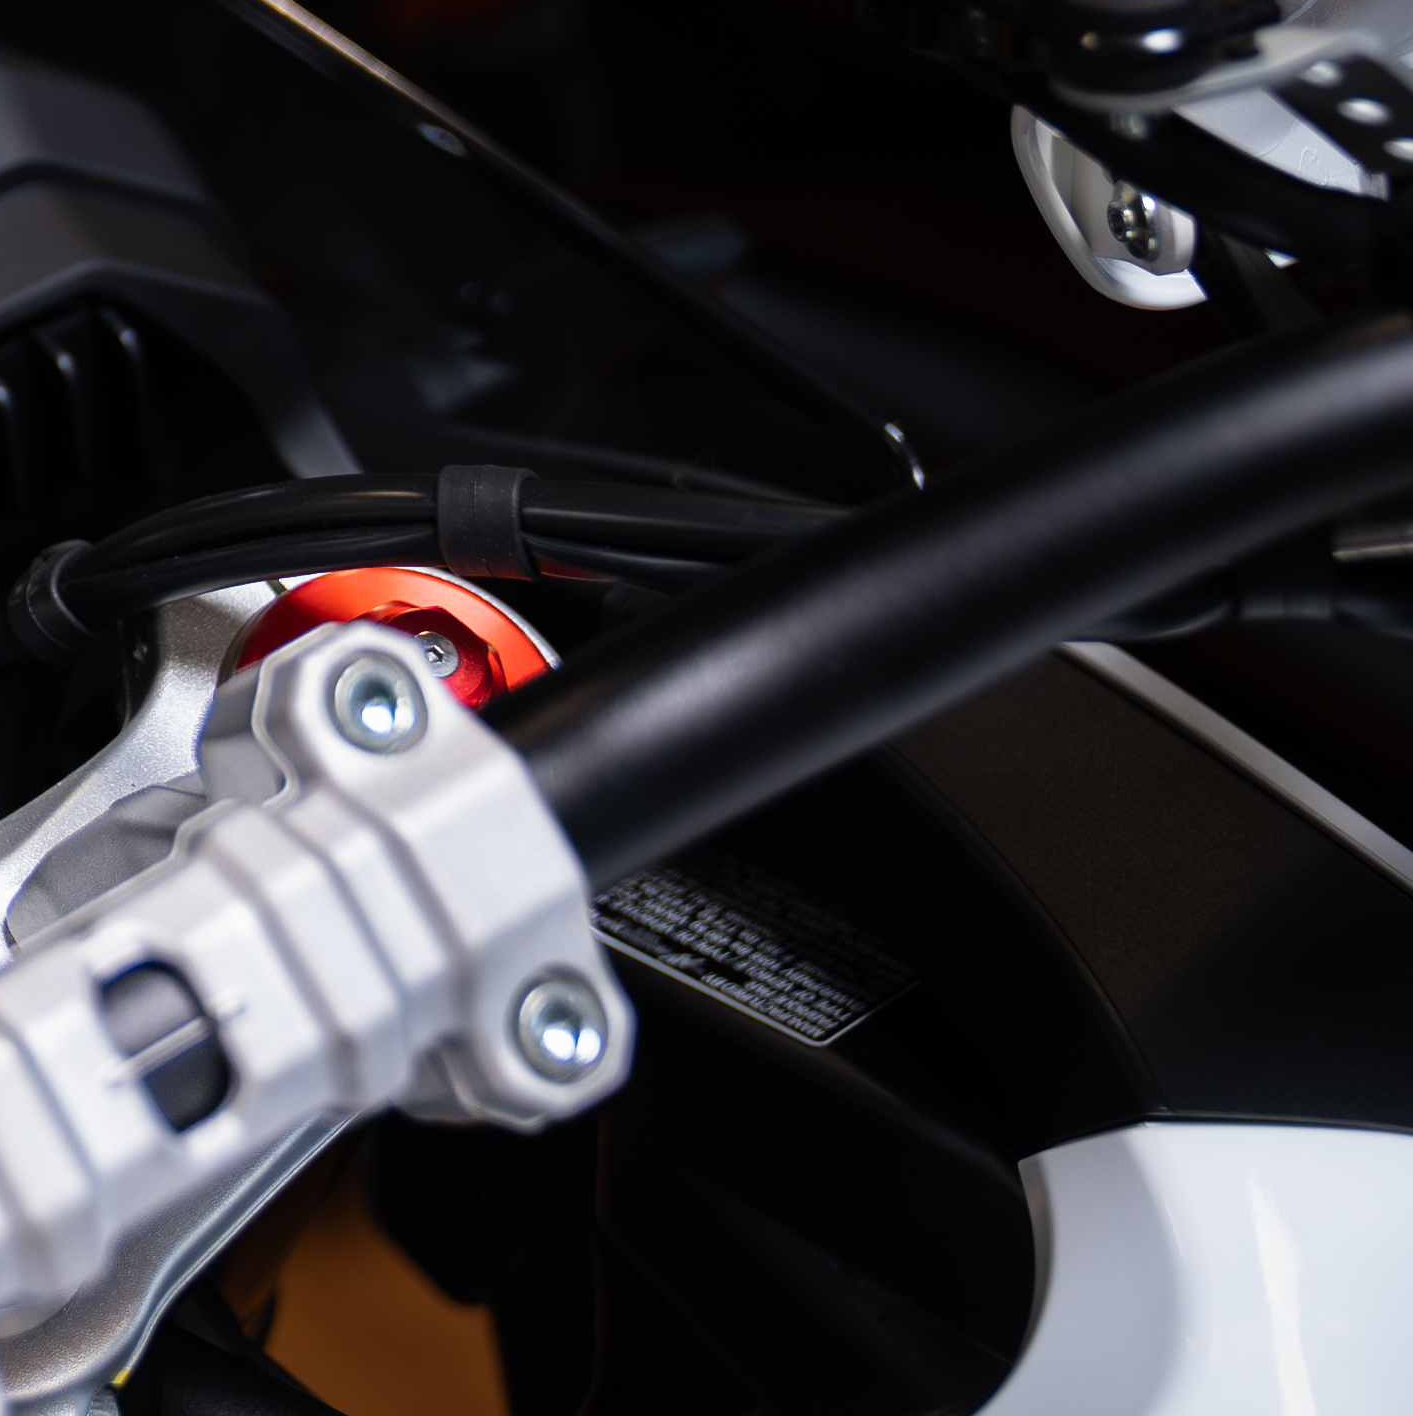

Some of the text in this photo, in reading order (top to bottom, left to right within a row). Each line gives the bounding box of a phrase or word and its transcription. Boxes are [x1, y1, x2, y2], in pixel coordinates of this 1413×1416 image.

[688, 937, 732, 962] TYPE
[731, 957, 796, 994] VEHICLE
[789, 986, 818, 1003] OF
[811, 997, 853, 1021] TYPE
